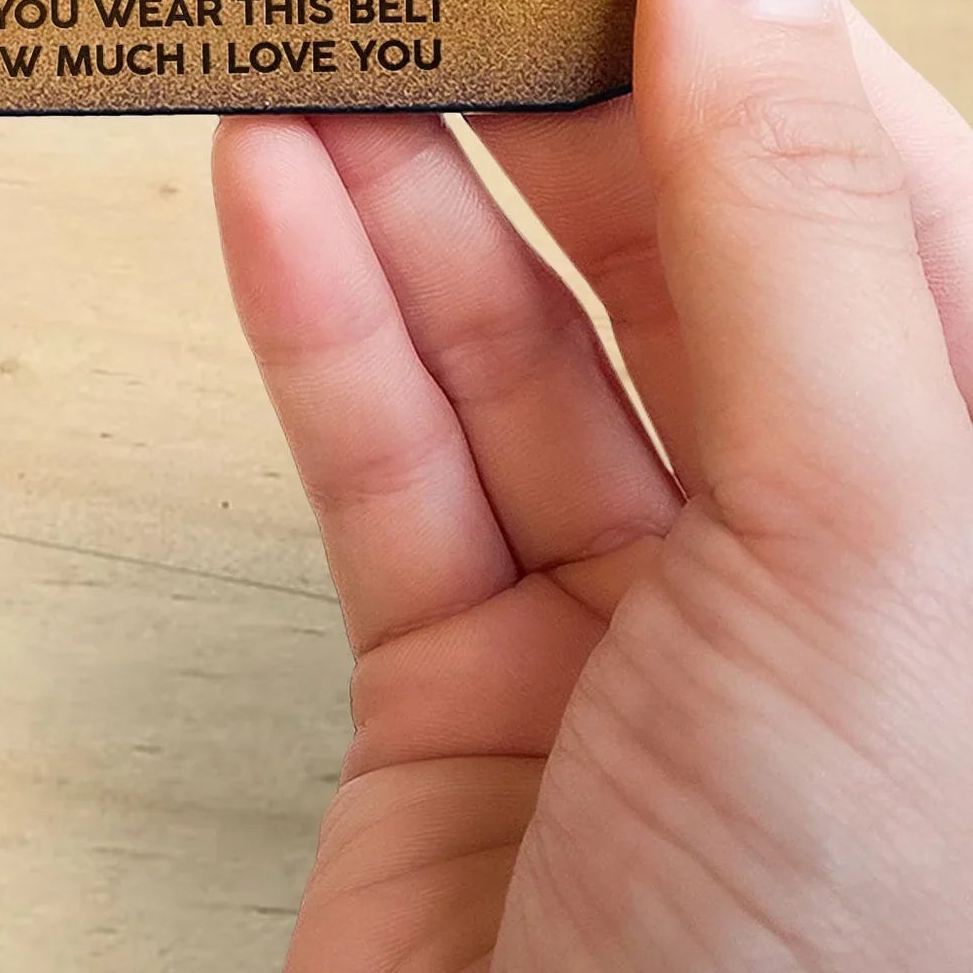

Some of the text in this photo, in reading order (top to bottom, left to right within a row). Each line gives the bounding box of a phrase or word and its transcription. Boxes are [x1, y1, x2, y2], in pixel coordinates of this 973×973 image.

[56, 42, 185, 78] MUCH
[202, 42, 212, 75] I
[227, 39, 340, 74] LOVE
[350, 37, 443, 72] YOU
